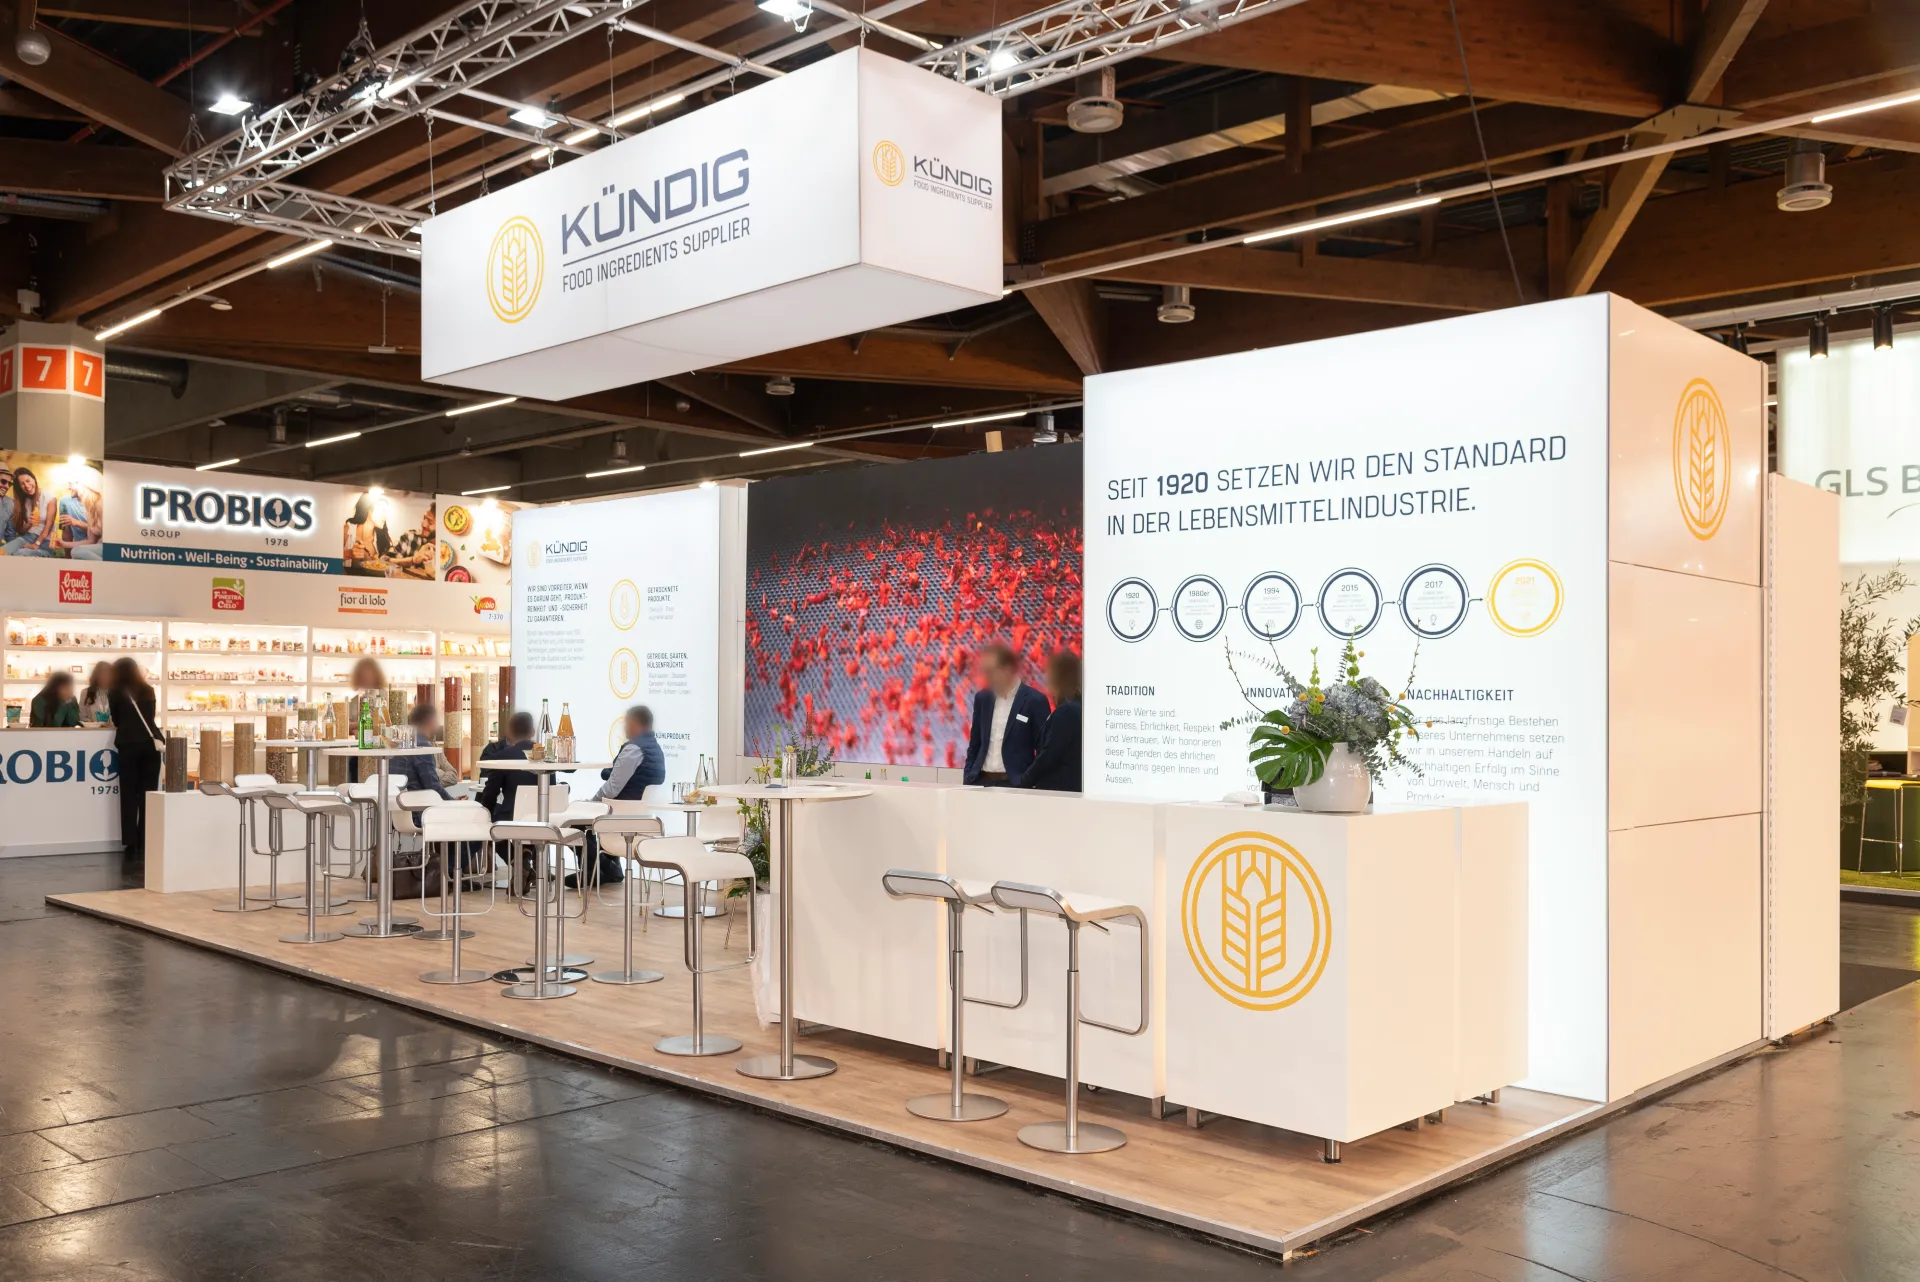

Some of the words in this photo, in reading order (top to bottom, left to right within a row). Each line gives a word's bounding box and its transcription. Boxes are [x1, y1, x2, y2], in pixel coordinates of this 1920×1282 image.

[914, 156, 992, 196] KÜNDIG
[562, 149, 749, 255] KÜNDIG
[914, 180, 929, 191] FOOD
[930, 185, 966, 202] INGREDIENTS
[967, 196, 993, 210] SUPPLIER
[563, 268, 593, 292] FOOD
[597, 240, 678, 282] INGREDIENTS
[683, 217, 750, 255] SUPPLIER
[36, 355, 52, 382] 7
[82, 359, 93, 387] 7
[1107, 477, 1148, 500] SEIT
[1156, 471, 1209, 496] 1920
[1217, 462, 1299, 492] SETZEN
[1309, 457, 1356, 483] WIR
[1365, 451, 1413, 478] DEN
[1424, 435, 1567, 473] STANDARD
[1815, 466, 1889, 497] GLS
[141, 487, 312, 531] PROBIOS
[1107, 514, 1125, 536] IN
[1132, 511, 1171, 534] DER
[1178, 487, 1477, 532] LEBENSMITTELINDUSTRIE.
[141, 529, 181, 538] GROUP
[265, 537, 288, 547] 1978
[545, 540, 588, 555] KÜNDIG
[120, 547, 175, 562] Nutrition
[185, 551, 247, 568] Well-Being
[256, 556, 329, 573] Sustainability
[1263, 587, 1280, 595] 1994
[1341, 584, 1359, 592] 2015
[1424, 580, 1443, 589] 2017
[340, 593, 357, 606] fior
[359, 594, 368, 605] di
[1105, 685, 1155, 696] TRADITION
[1246, 687, 1293, 698] INNOVAT
[1407, 689, 1514, 701] NACHHALTIGKEIT
[1105, 706, 1132, 716] Unsere
[1134, 707, 1157, 717] Werte
[1509, 715, 1559, 727] Bestehen
[1183, 723, 1215, 734] Respekt
[655, 732, 690, 741] KÜHLPRODUKTE
[1105, 734, 1119, 743] und
[1161, 736, 1176, 745] Wir
[1178, 737, 1222, 748] honorieren
[1449, 731, 1525, 742] Unternehmens
[1529, 733, 1565, 744] setzen
[1105, 747, 1125, 757] diese
[1127, 748, 1161, 759] Tugenden
[1163, 750, 1178, 759] des
[1180, 750, 1216, 761] ehrlichen
[1407, 746, 1423, 755] wir
[1426, 746, 1435, 756] in
[1439, 746, 1484, 757] unserem
[1488, 747, 1531, 759] Handeln
[1535, 748, 1554, 760] auf
[1105, 760, 1149, 771] Kaufmanns
[1151, 764, 1175, 775] gegen
[1178, 764, 1200, 774] Innen
[1203, 765, 1219, 776] und
[1410, 760, 1471, 775] chhaltigen
[1475, 763, 1507, 777] Erfolg
[1511, 765, 1525, 775] im
[1529, 765, 1560, 777] Sinne
[1105, 774, 1134, 784] Aussen.
[1407, 778, 1424, 787] von
[1473, 778, 1515, 791] Mensch
[1519, 781, 1540, 792] und
[91, 786, 119, 795] 1978
